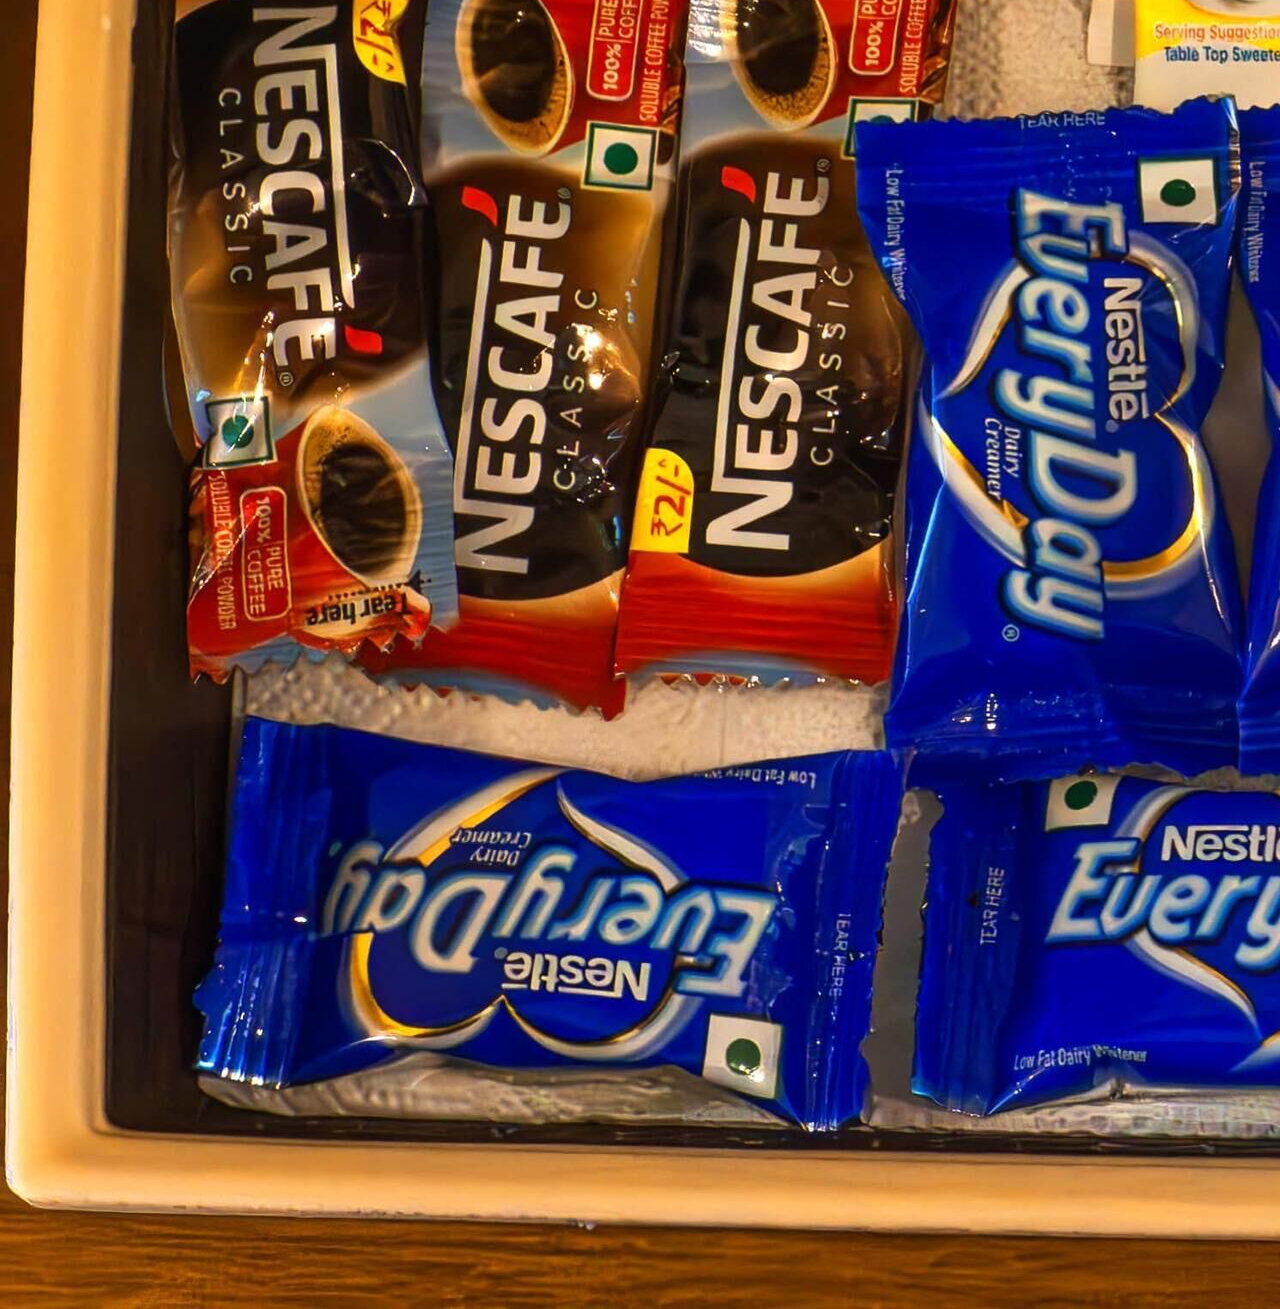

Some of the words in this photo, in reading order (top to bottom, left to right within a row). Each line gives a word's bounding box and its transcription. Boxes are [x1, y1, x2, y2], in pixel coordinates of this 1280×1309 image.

[644, 23, 667, 66] COFFEE
[865, 20, 885, 66] 100%
[1155, 24, 1206, 41] Serving
[603, 43, 622, 90] 100%
[900, 42, 922, 94] SOLUBLE
[1164, 46, 1199, 62] Table
[1203, 46, 1228, 64] Top
[640, 68, 662, 123] SOLUBLE
[1063, 112, 1105, 127] HERE
[218, 88, 252, 284] CLASSIC
[886, 170, 904, 197] Low
[1249, 161, 1266, 188] Low
[884, 216, 905, 246] Dairy
[810, 265, 854, 466] CLASSIC
[553, 289, 597, 490] CLASSC
[995, 187, 1138, 640] EveryDay
[984, 417, 1001, 500] Creamer
[1003, 426, 1021, 478] Dairy
[256, 495, 271, 542] 100%
[267, 545, 285, 590] PURE
[248, 549, 266, 615] COFFEE
[306, 603, 356, 626] here
[359, 592, 410, 618] Tear
[765, 769, 785, 785] Fat
[788, 770, 817, 789] Low
[450, 827, 532, 847] Creamer
[470, 848, 520, 867] Dairy
[985, 866, 1005, 906] HERE
[316, 840, 779, 999] EveryDay
[980, 909, 998, 945] TEAR
[829, 955, 847, 996] HERE
[1014, 1055, 1035, 1070] Low
[1037, 1050, 1055, 1067] Fat
[1057, 1047, 1091, 1066] Dairy
